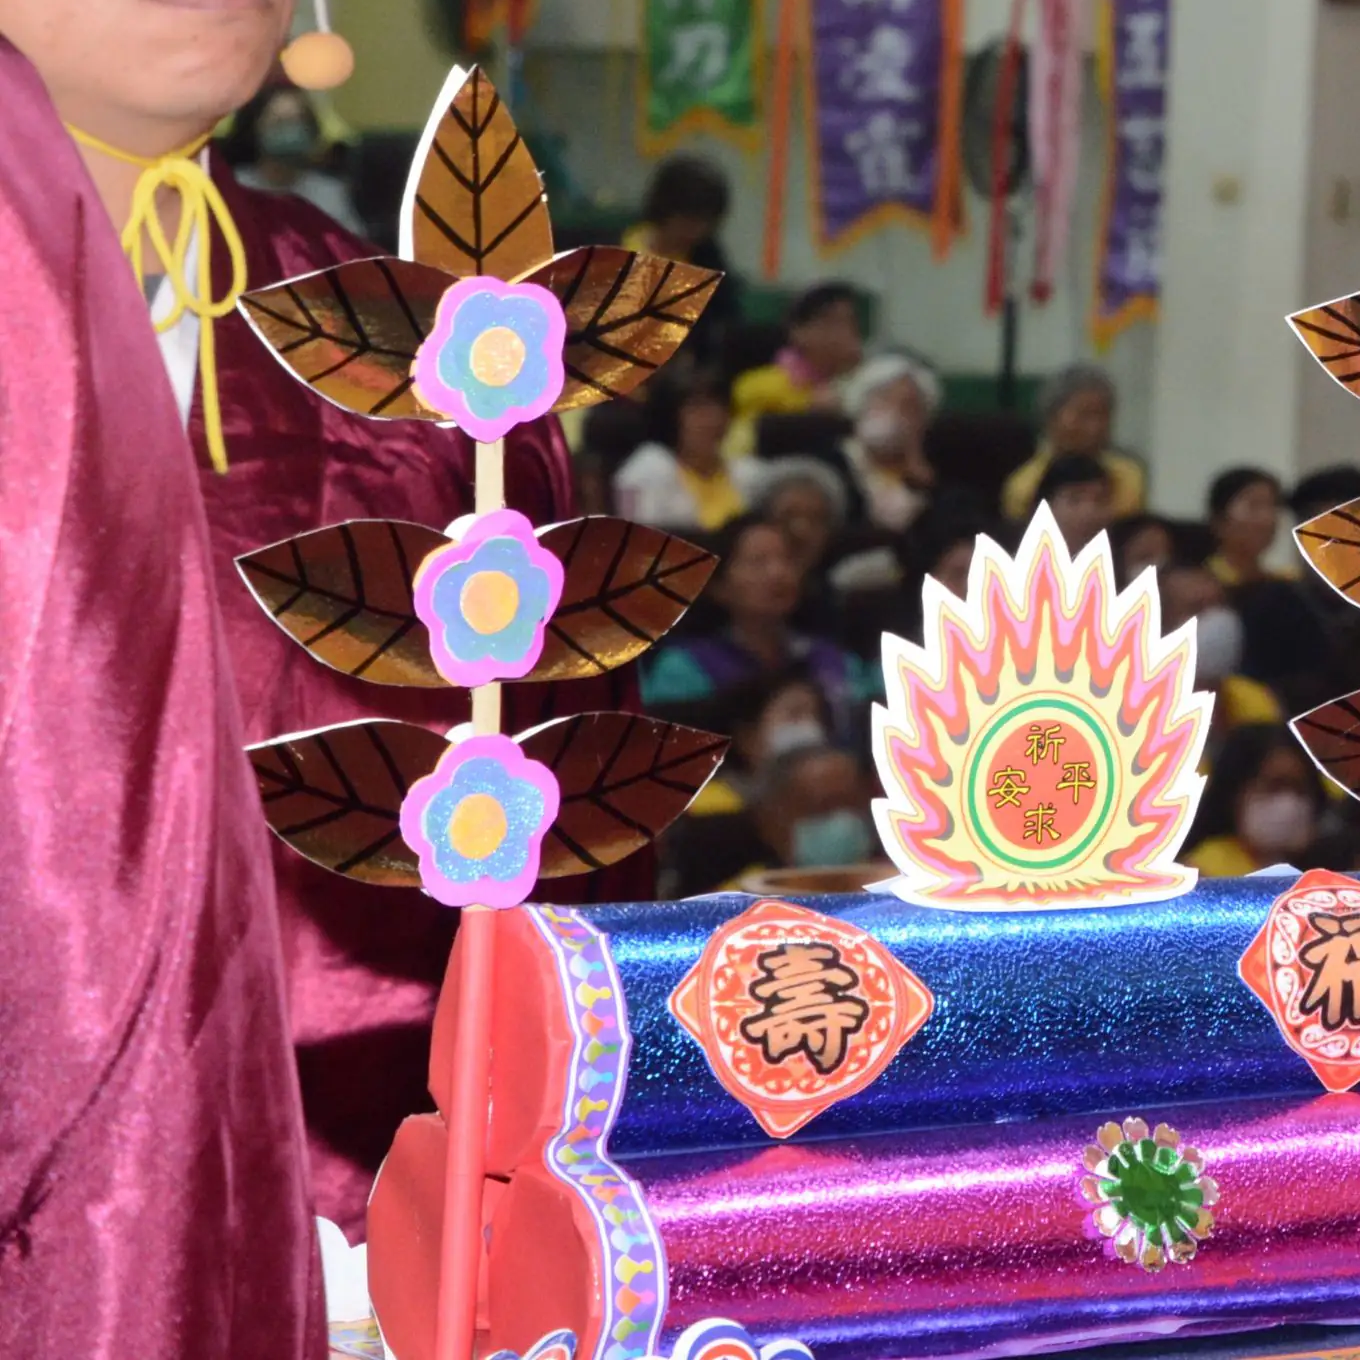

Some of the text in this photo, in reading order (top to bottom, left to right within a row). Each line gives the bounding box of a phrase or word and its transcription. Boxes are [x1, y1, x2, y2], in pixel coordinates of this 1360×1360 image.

[1025, 723, 1066, 765] 祈
[987, 766, 1031, 809] 安
[1055, 761, 1098, 805] 平
[1022, 801, 1062, 844] 求
[739, 941, 870, 1076] 壽
